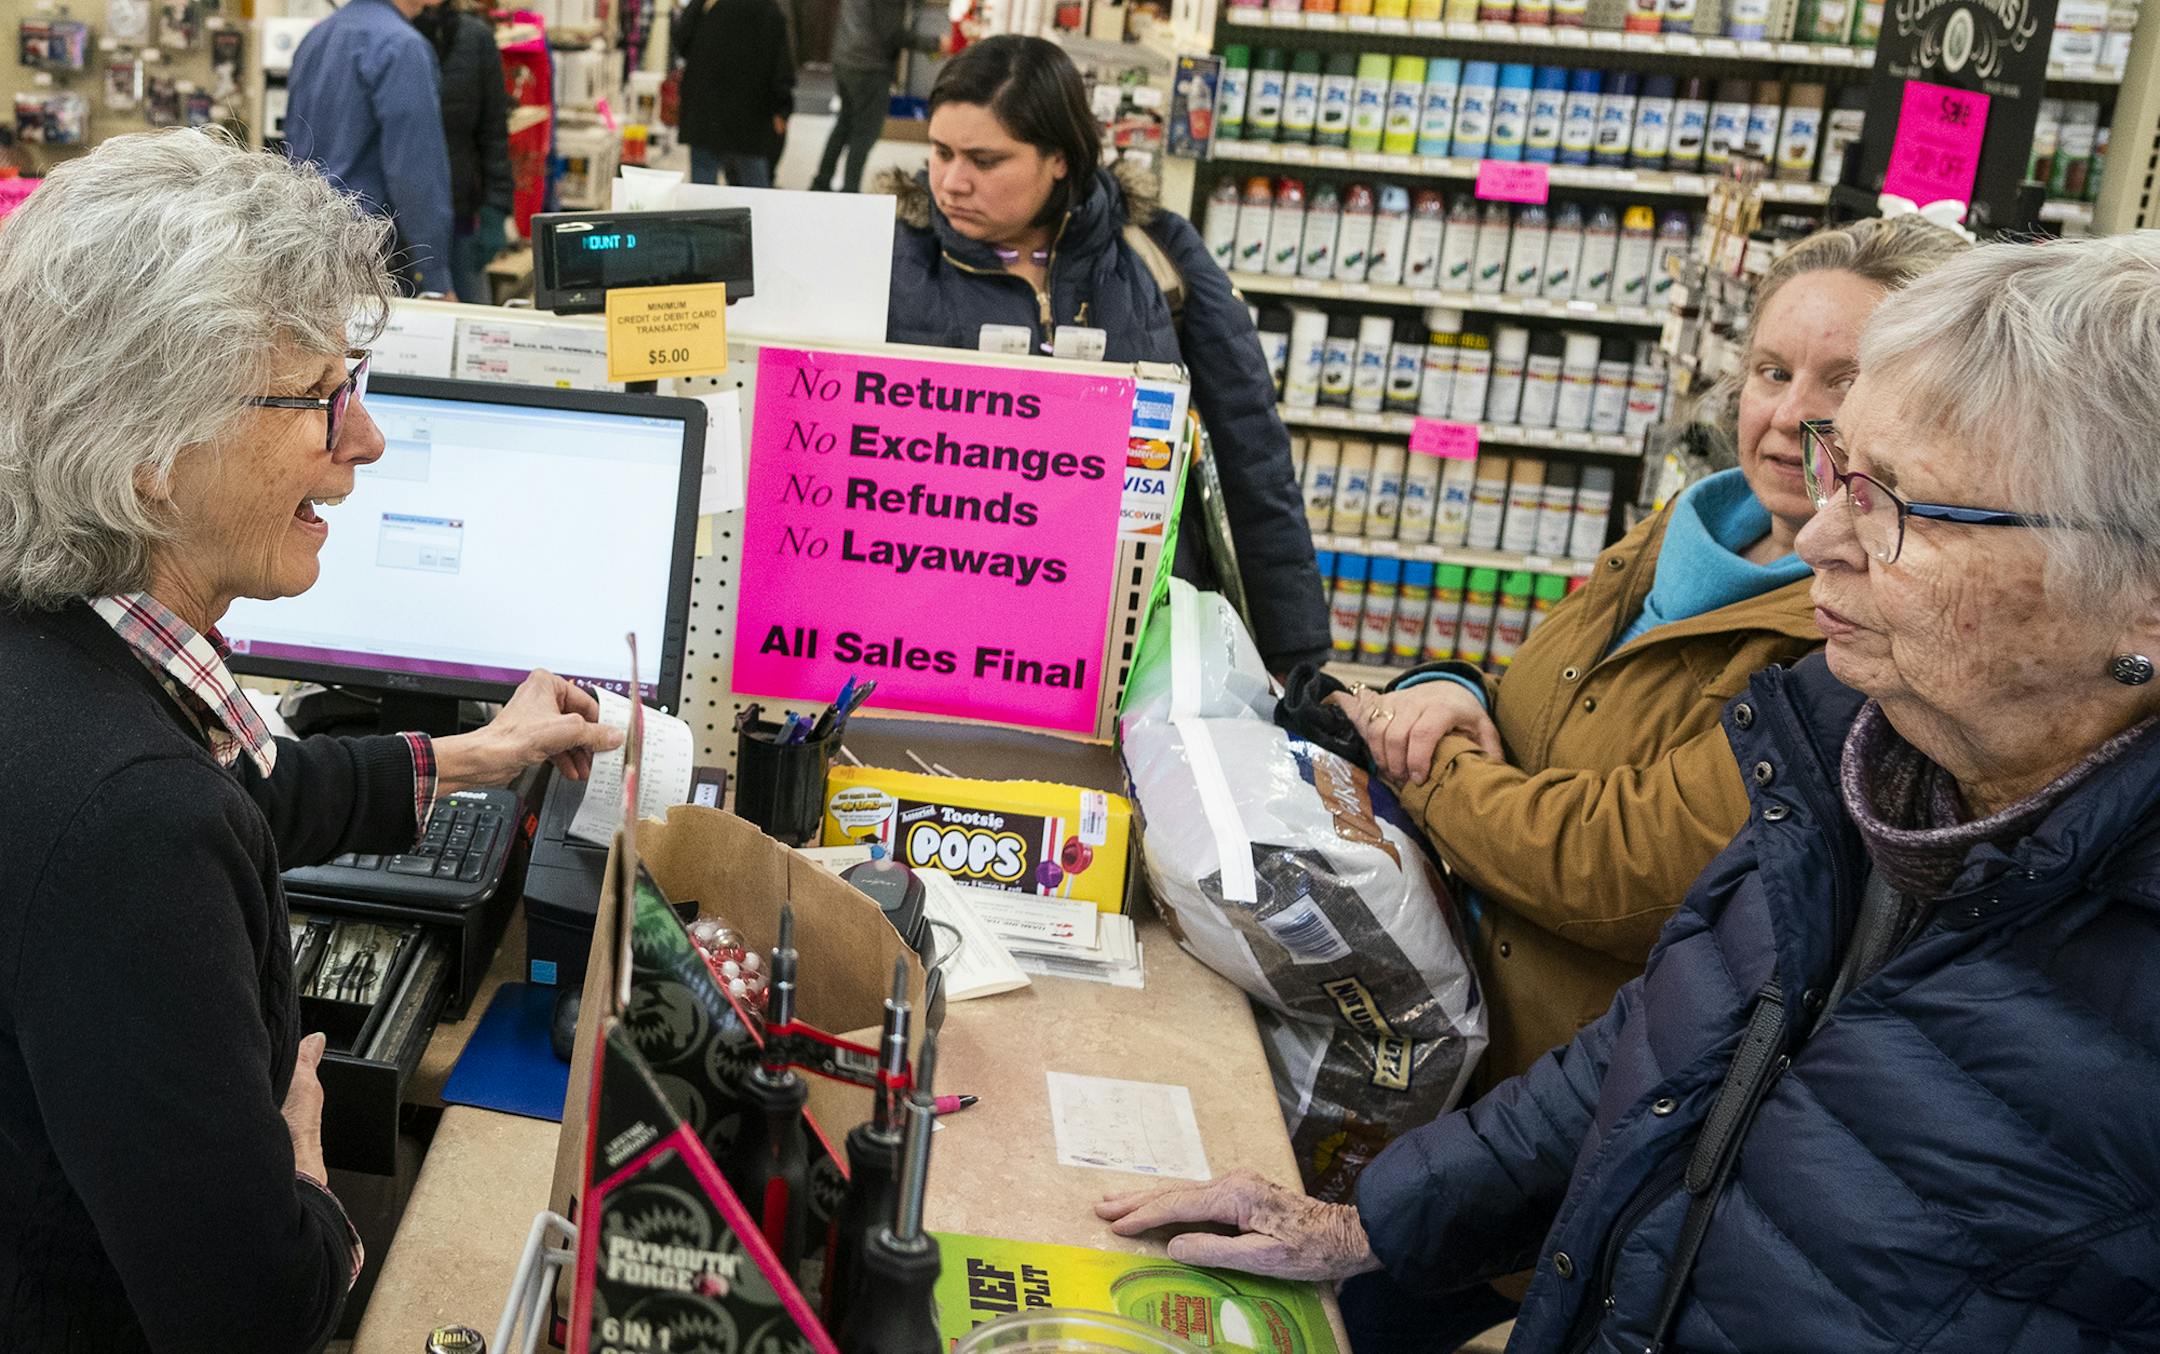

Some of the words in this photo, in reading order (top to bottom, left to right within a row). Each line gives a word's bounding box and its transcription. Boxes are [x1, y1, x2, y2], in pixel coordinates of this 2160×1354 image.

[617, 314, 650, 325] CREDIT
[664, 312, 689, 322] DEBIT
[692, 310, 717, 319] CARD
[648, 301, 687, 311] MINIMUM
[636, 322, 700, 334] TRANSACTION
[649, 348, 690, 365] $5.00
[789, 367, 841, 402] No
[854, 370, 1042, 419] Returns
[785, 420, 837, 456] No
[849, 424, 1106, 482] Exchanges
[780, 473, 833, 508] No
[845, 477, 1039, 527] Refunds
[1123, 477, 1165, 495] VISA
[776, 526, 829, 560] No
[841, 530, 1068, 587] Layaways
[759, 625, 818, 659] All
[833, 632, 957, 675] Sales
[973, 646, 1086, 690] Final
[941, 807, 1004, 830] Tootsie
[911, 825, 1022, 878] POPS
[606, 1255, 694, 1292] FORGE
[609, 1235, 740, 1277] PLYMOUTH
[1021, 1264, 1053, 1309] PLIT
[602, 1317, 620, 1342] 6
[623, 1320, 651, 1348] IN
[658, 1326, 671, 1350] 1
